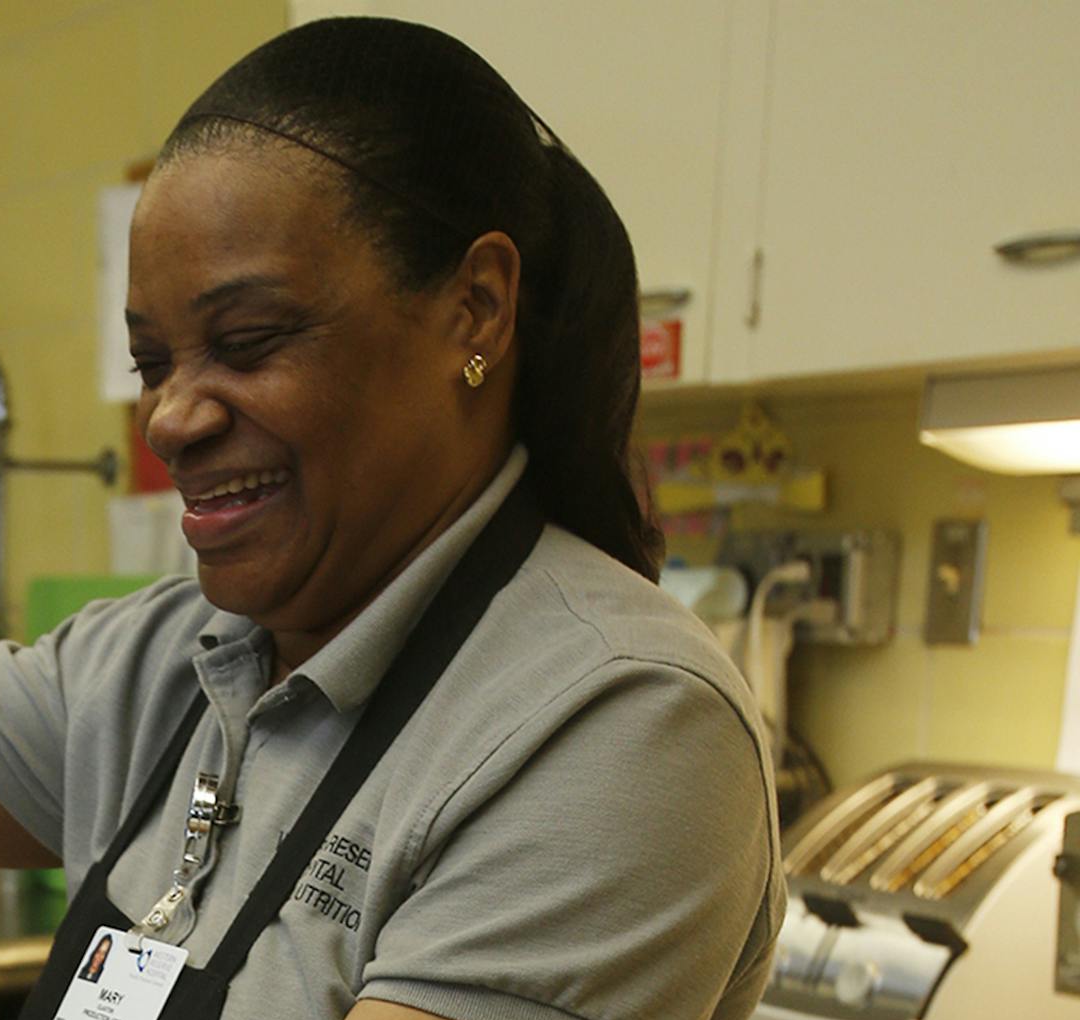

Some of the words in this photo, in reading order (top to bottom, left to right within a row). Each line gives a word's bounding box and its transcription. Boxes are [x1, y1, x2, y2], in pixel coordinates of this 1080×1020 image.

[309, 859, 345, 891] ITAL
[294, 883, 361, 932] UTRITIO
[98, 987, 125, 1005] MARY
